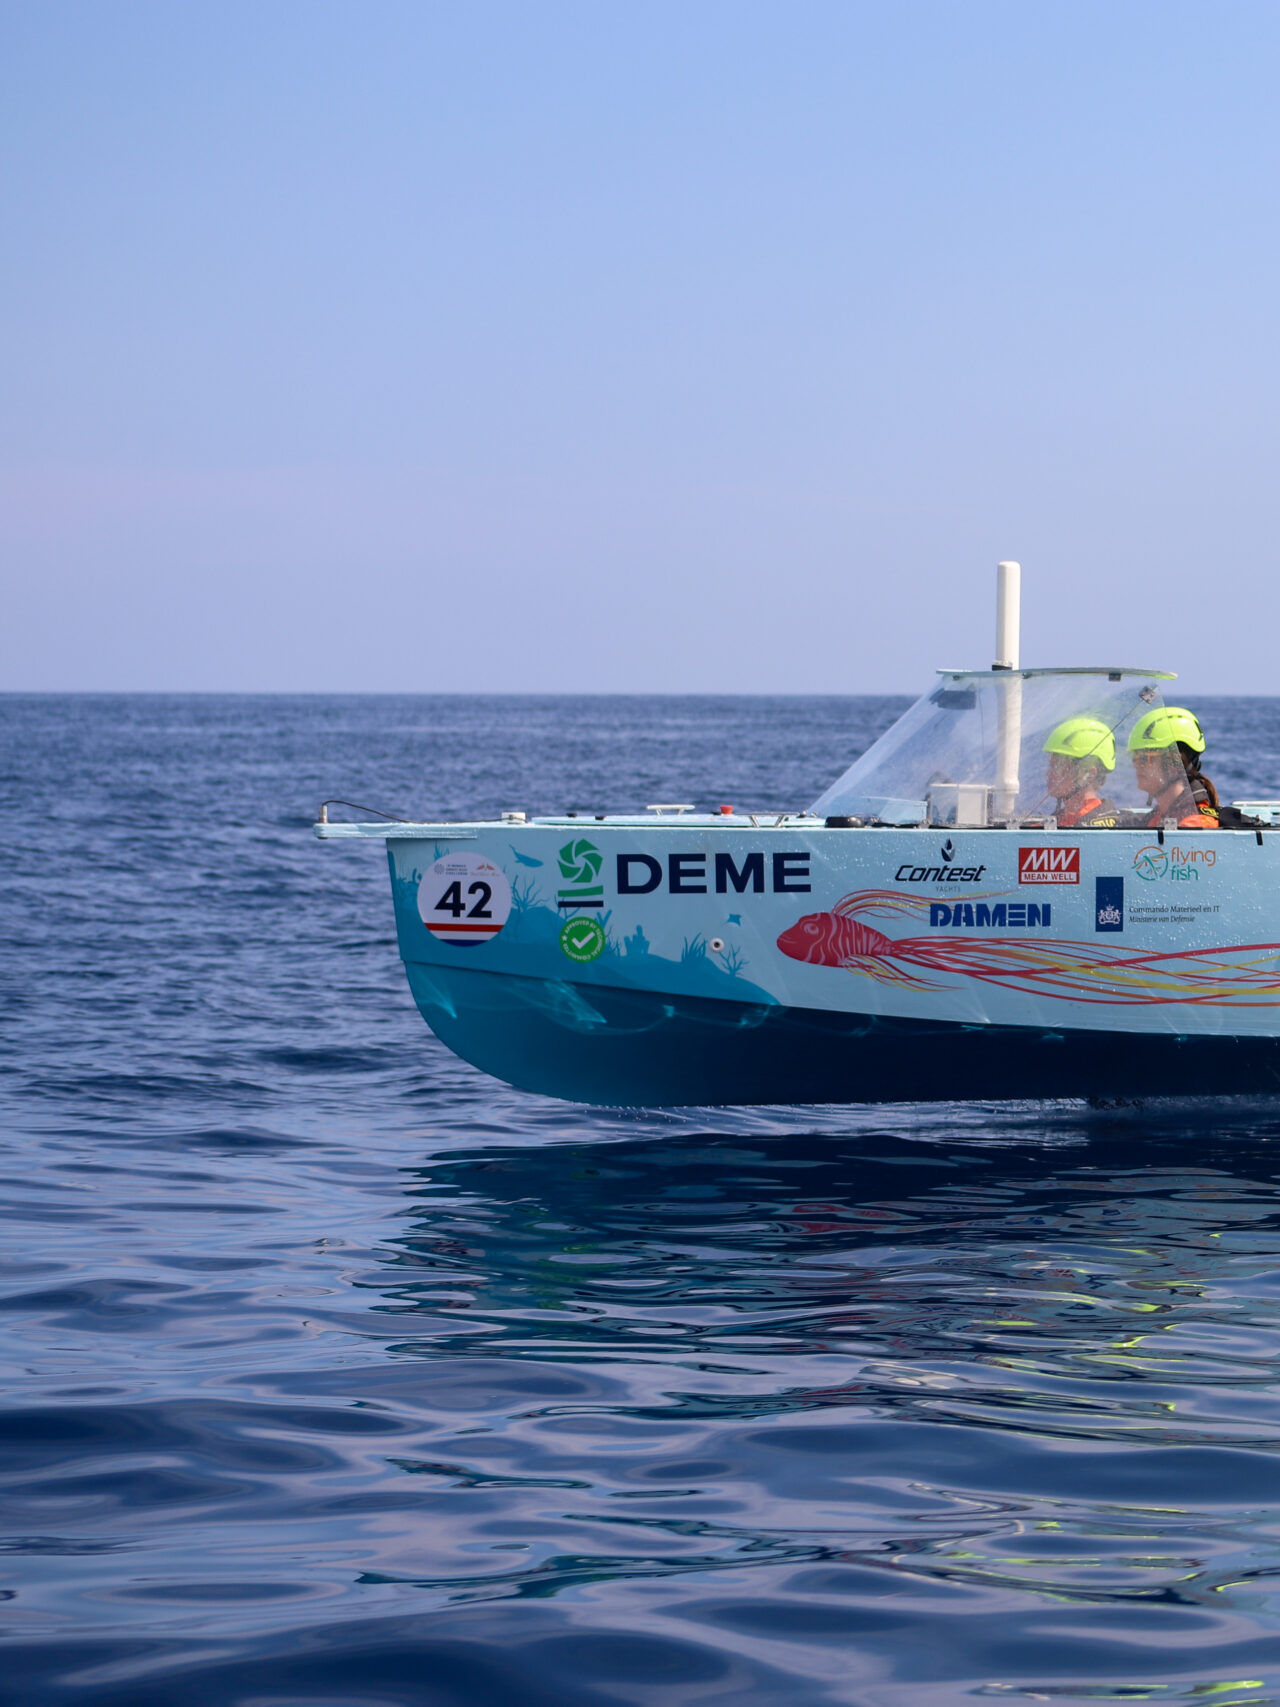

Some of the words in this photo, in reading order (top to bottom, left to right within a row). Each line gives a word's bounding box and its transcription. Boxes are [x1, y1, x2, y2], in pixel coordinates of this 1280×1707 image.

[1021, 848, 1079, 870] MW
[1170, 846, 1216, 866] flying
[616, 852, 811, 895] DEME
[894, 864, 987, 882] Contest
[1023, 872, 1049, 882] MEAN
[1051, 872, 1075, 882] WELL
[1170, 864, 1199, 881] fish
[434, 880, 493, 918] 42
[929, 903, 1051, 927] DAMEN
[1129, 905, 1169, 914] Commando
[1170, 905, 1202, 913] Materieel
[1213, 905, 1220, 913] IT
[1129, 915, 1158, 923] Ministerie
[1170, 915, 1196, 925] Defensie
